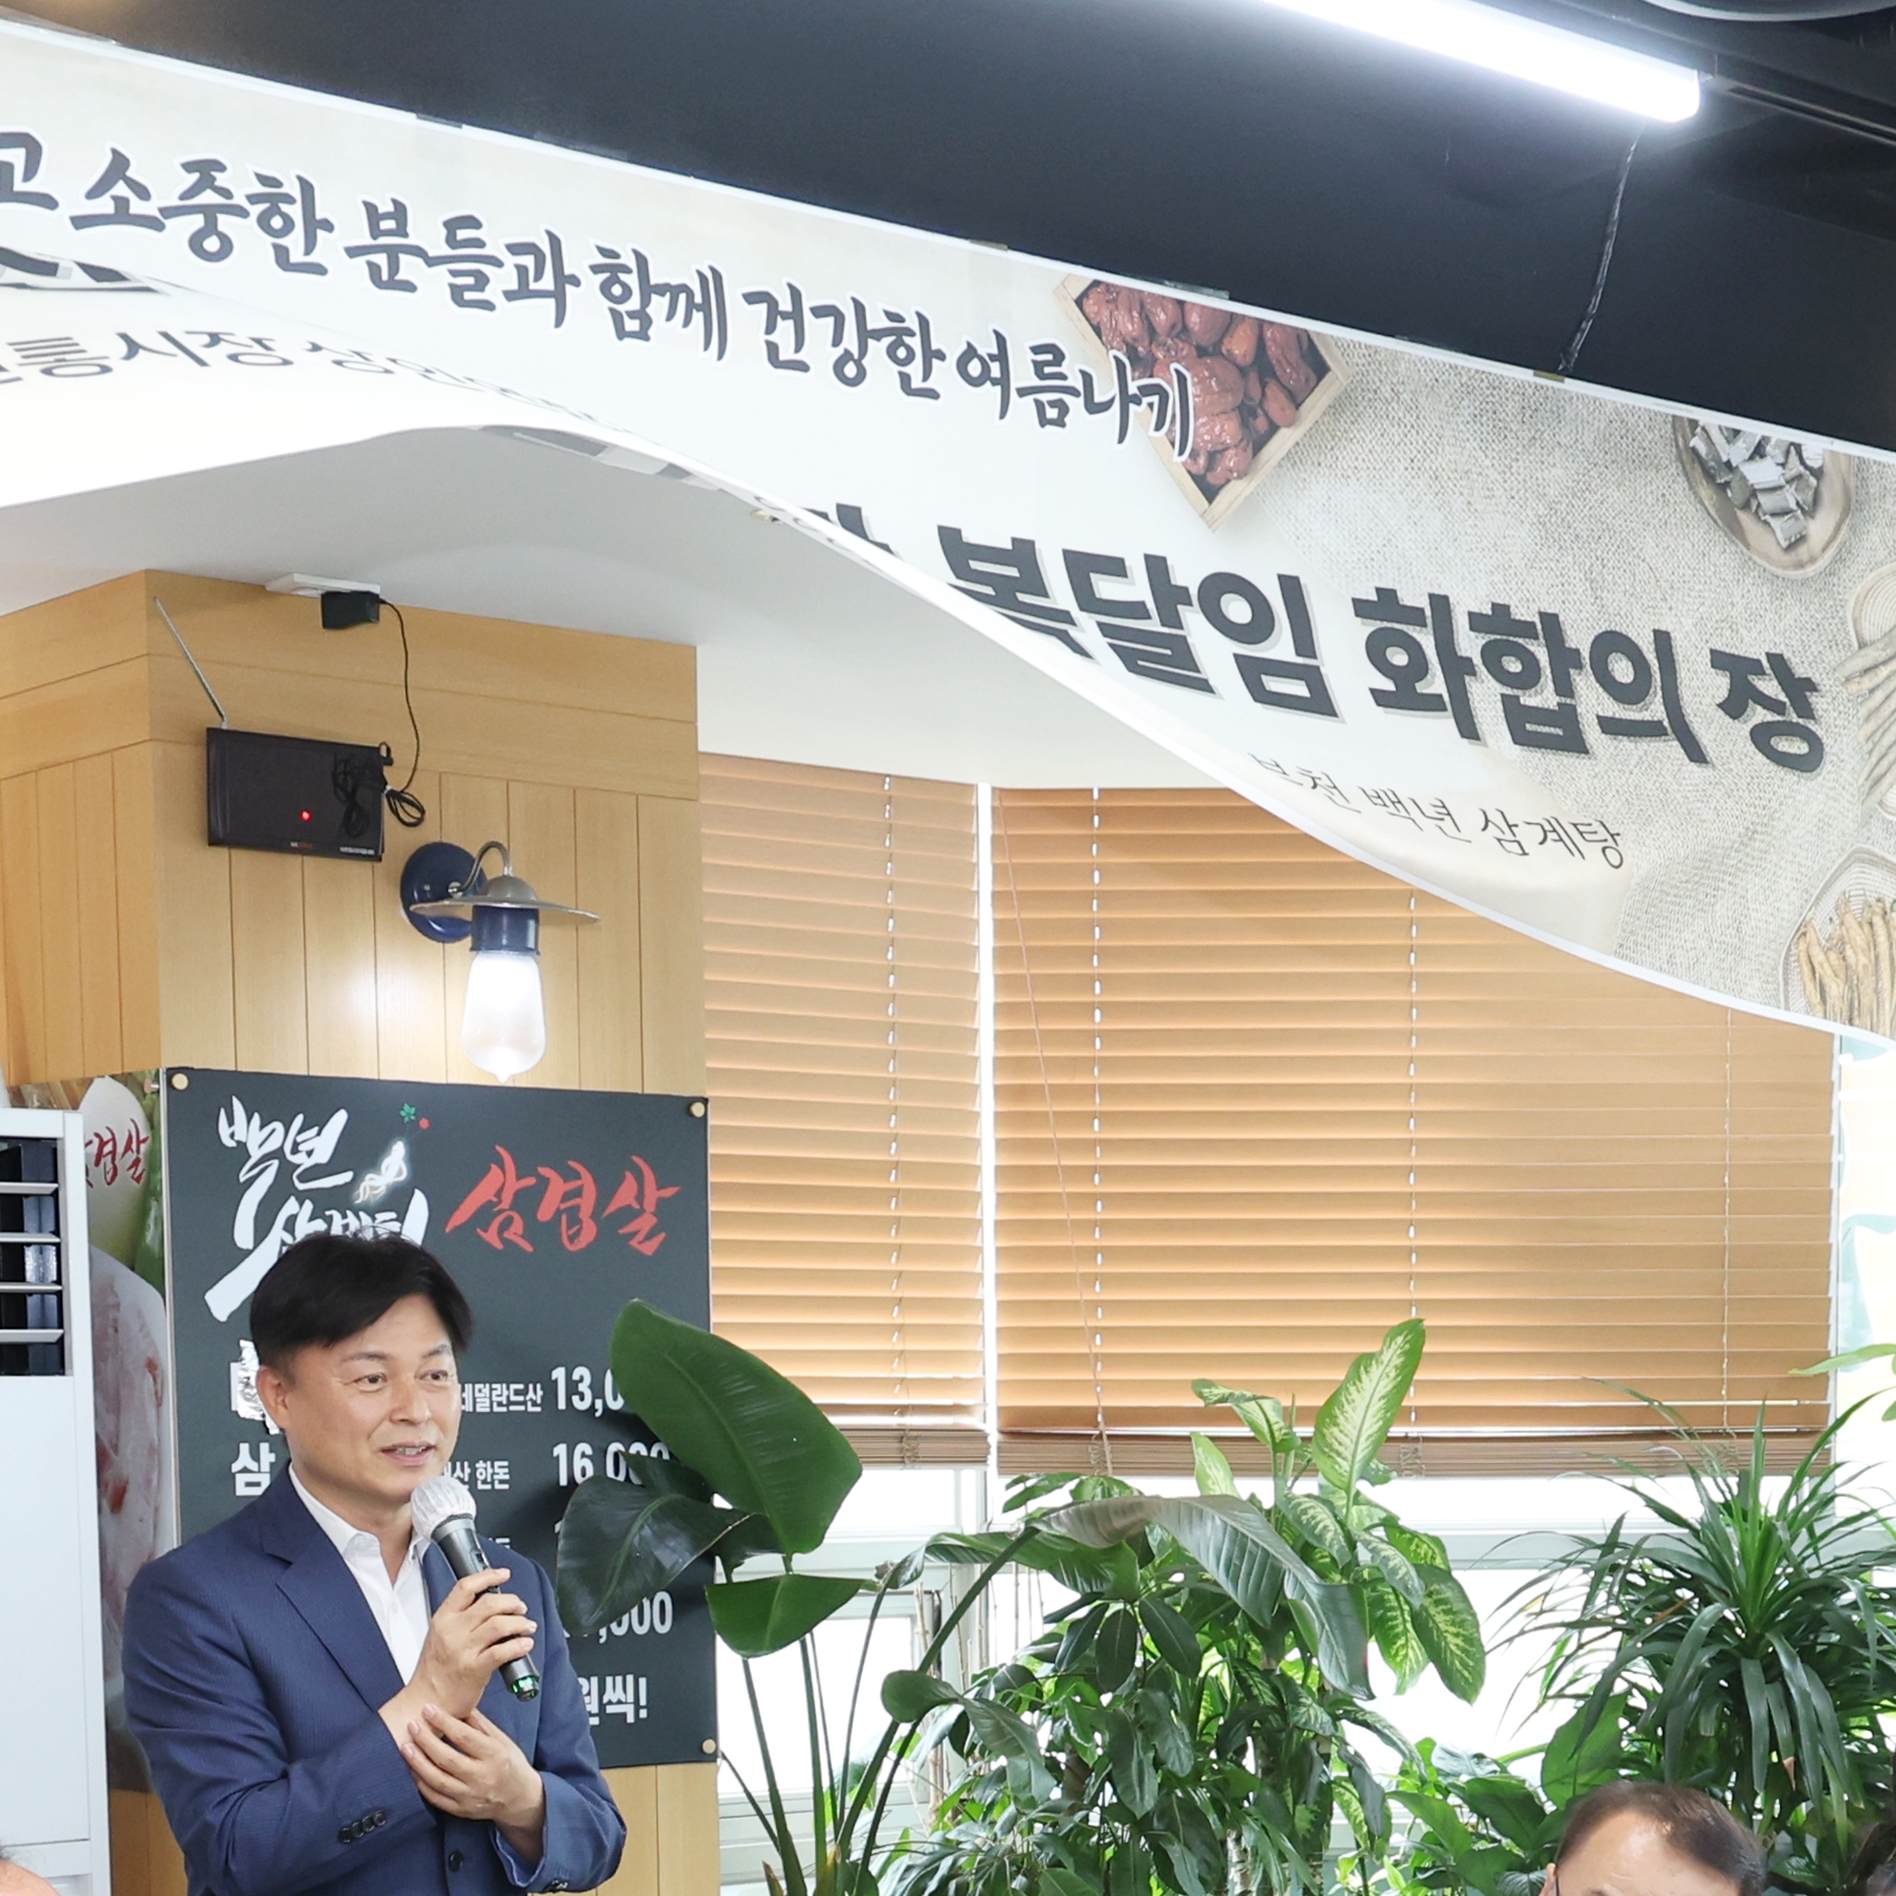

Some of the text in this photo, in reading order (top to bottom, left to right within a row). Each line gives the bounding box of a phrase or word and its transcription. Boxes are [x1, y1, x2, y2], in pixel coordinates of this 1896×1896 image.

[68, 147, 335, 276] 소중한
[344, 198, 581, 330] 분들과
[590, 243, 727, 362] 함께
[741, 281, 946, 401] 건강한
[956, 328, 1193, 460] 여름나기
[936, 524, 1825, 773] 복달임 화합의 장
[1358, 786, 1472, 843] 백년
[1480, 808, 1624, 869] 삼계탕
[218, 1095, 354, 1251] 백년
[445, 1145, 681, 1256] 삼겹살
[551, 1366, 626, 1418] 13,0
[475, 1460, 510, 1490] 한돈
